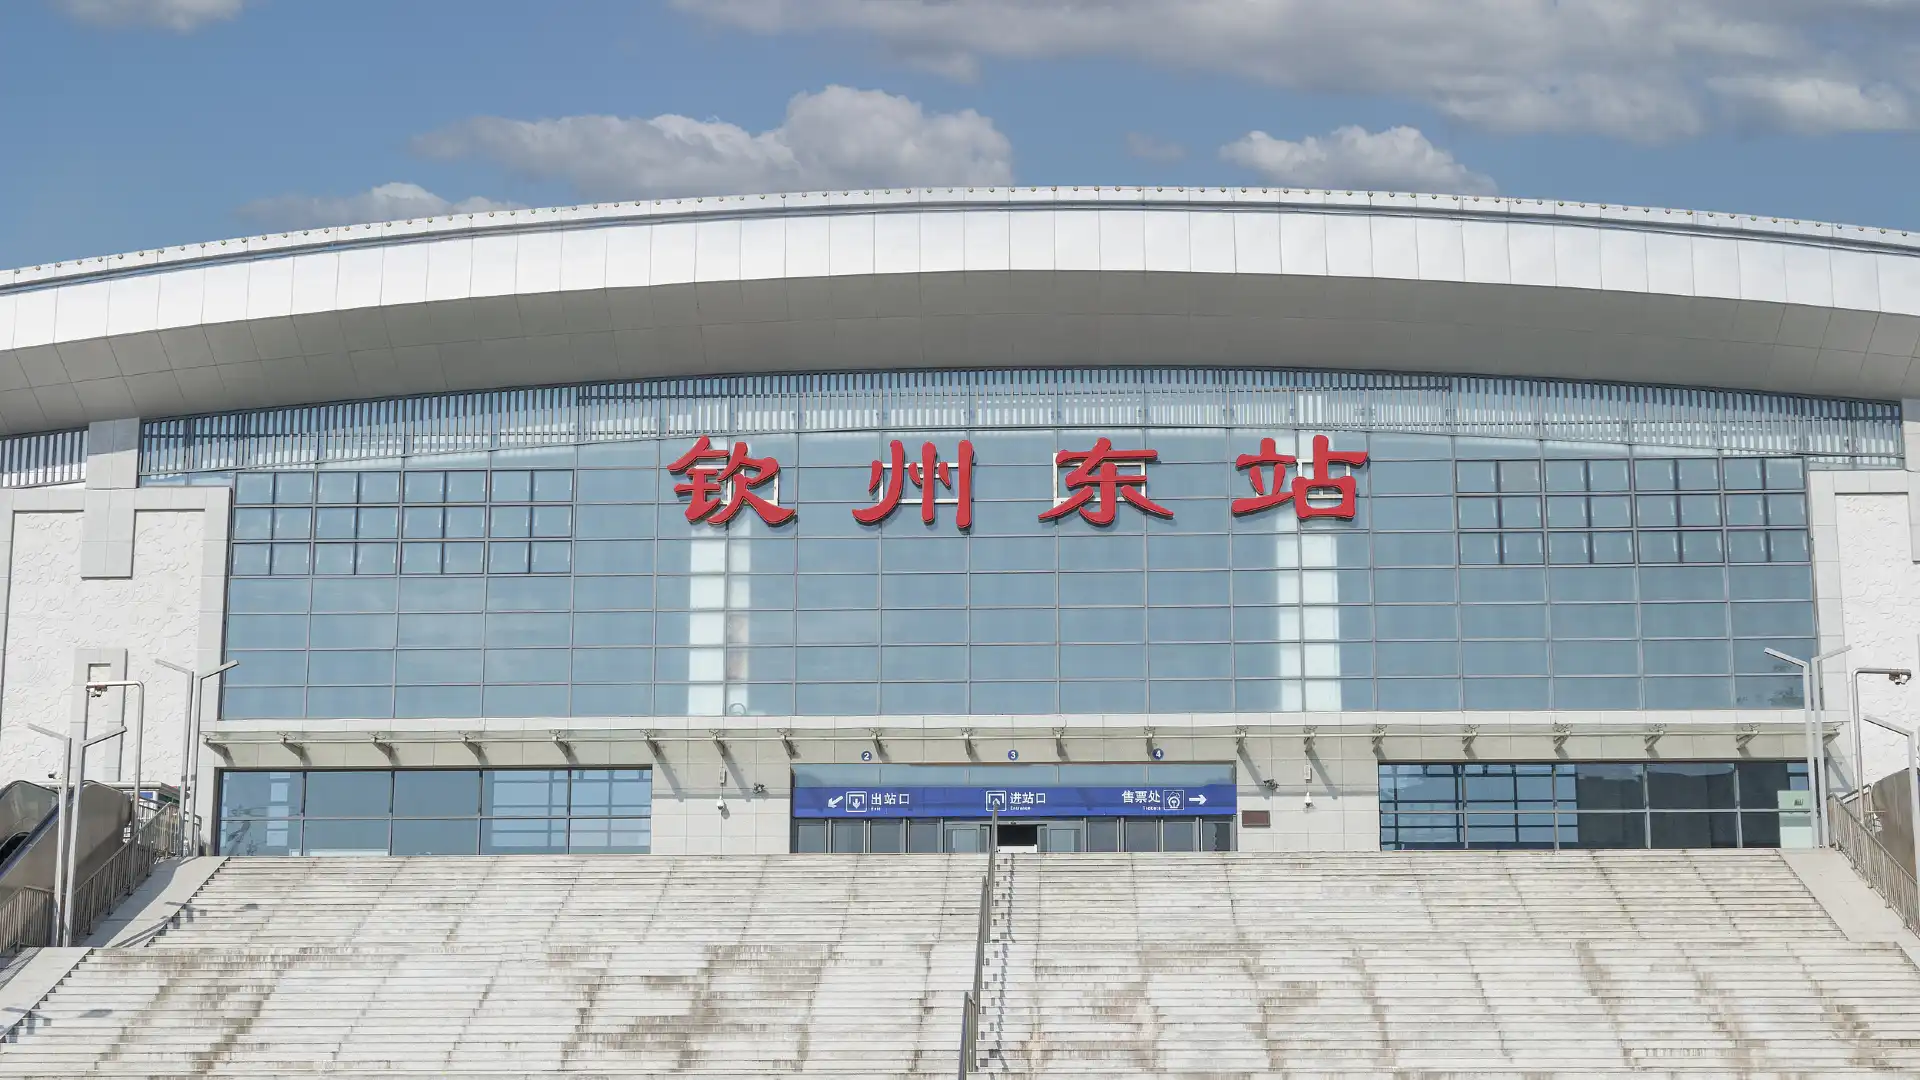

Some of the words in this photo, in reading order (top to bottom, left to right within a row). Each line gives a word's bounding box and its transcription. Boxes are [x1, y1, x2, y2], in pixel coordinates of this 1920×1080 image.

[667, 434, 1369, 528] 钦州东站
[871, 793, 910, 805] 出站口
[1010, 792, 1046, 804] 进站口
[1121, 790, 1161, 804] 售票处
